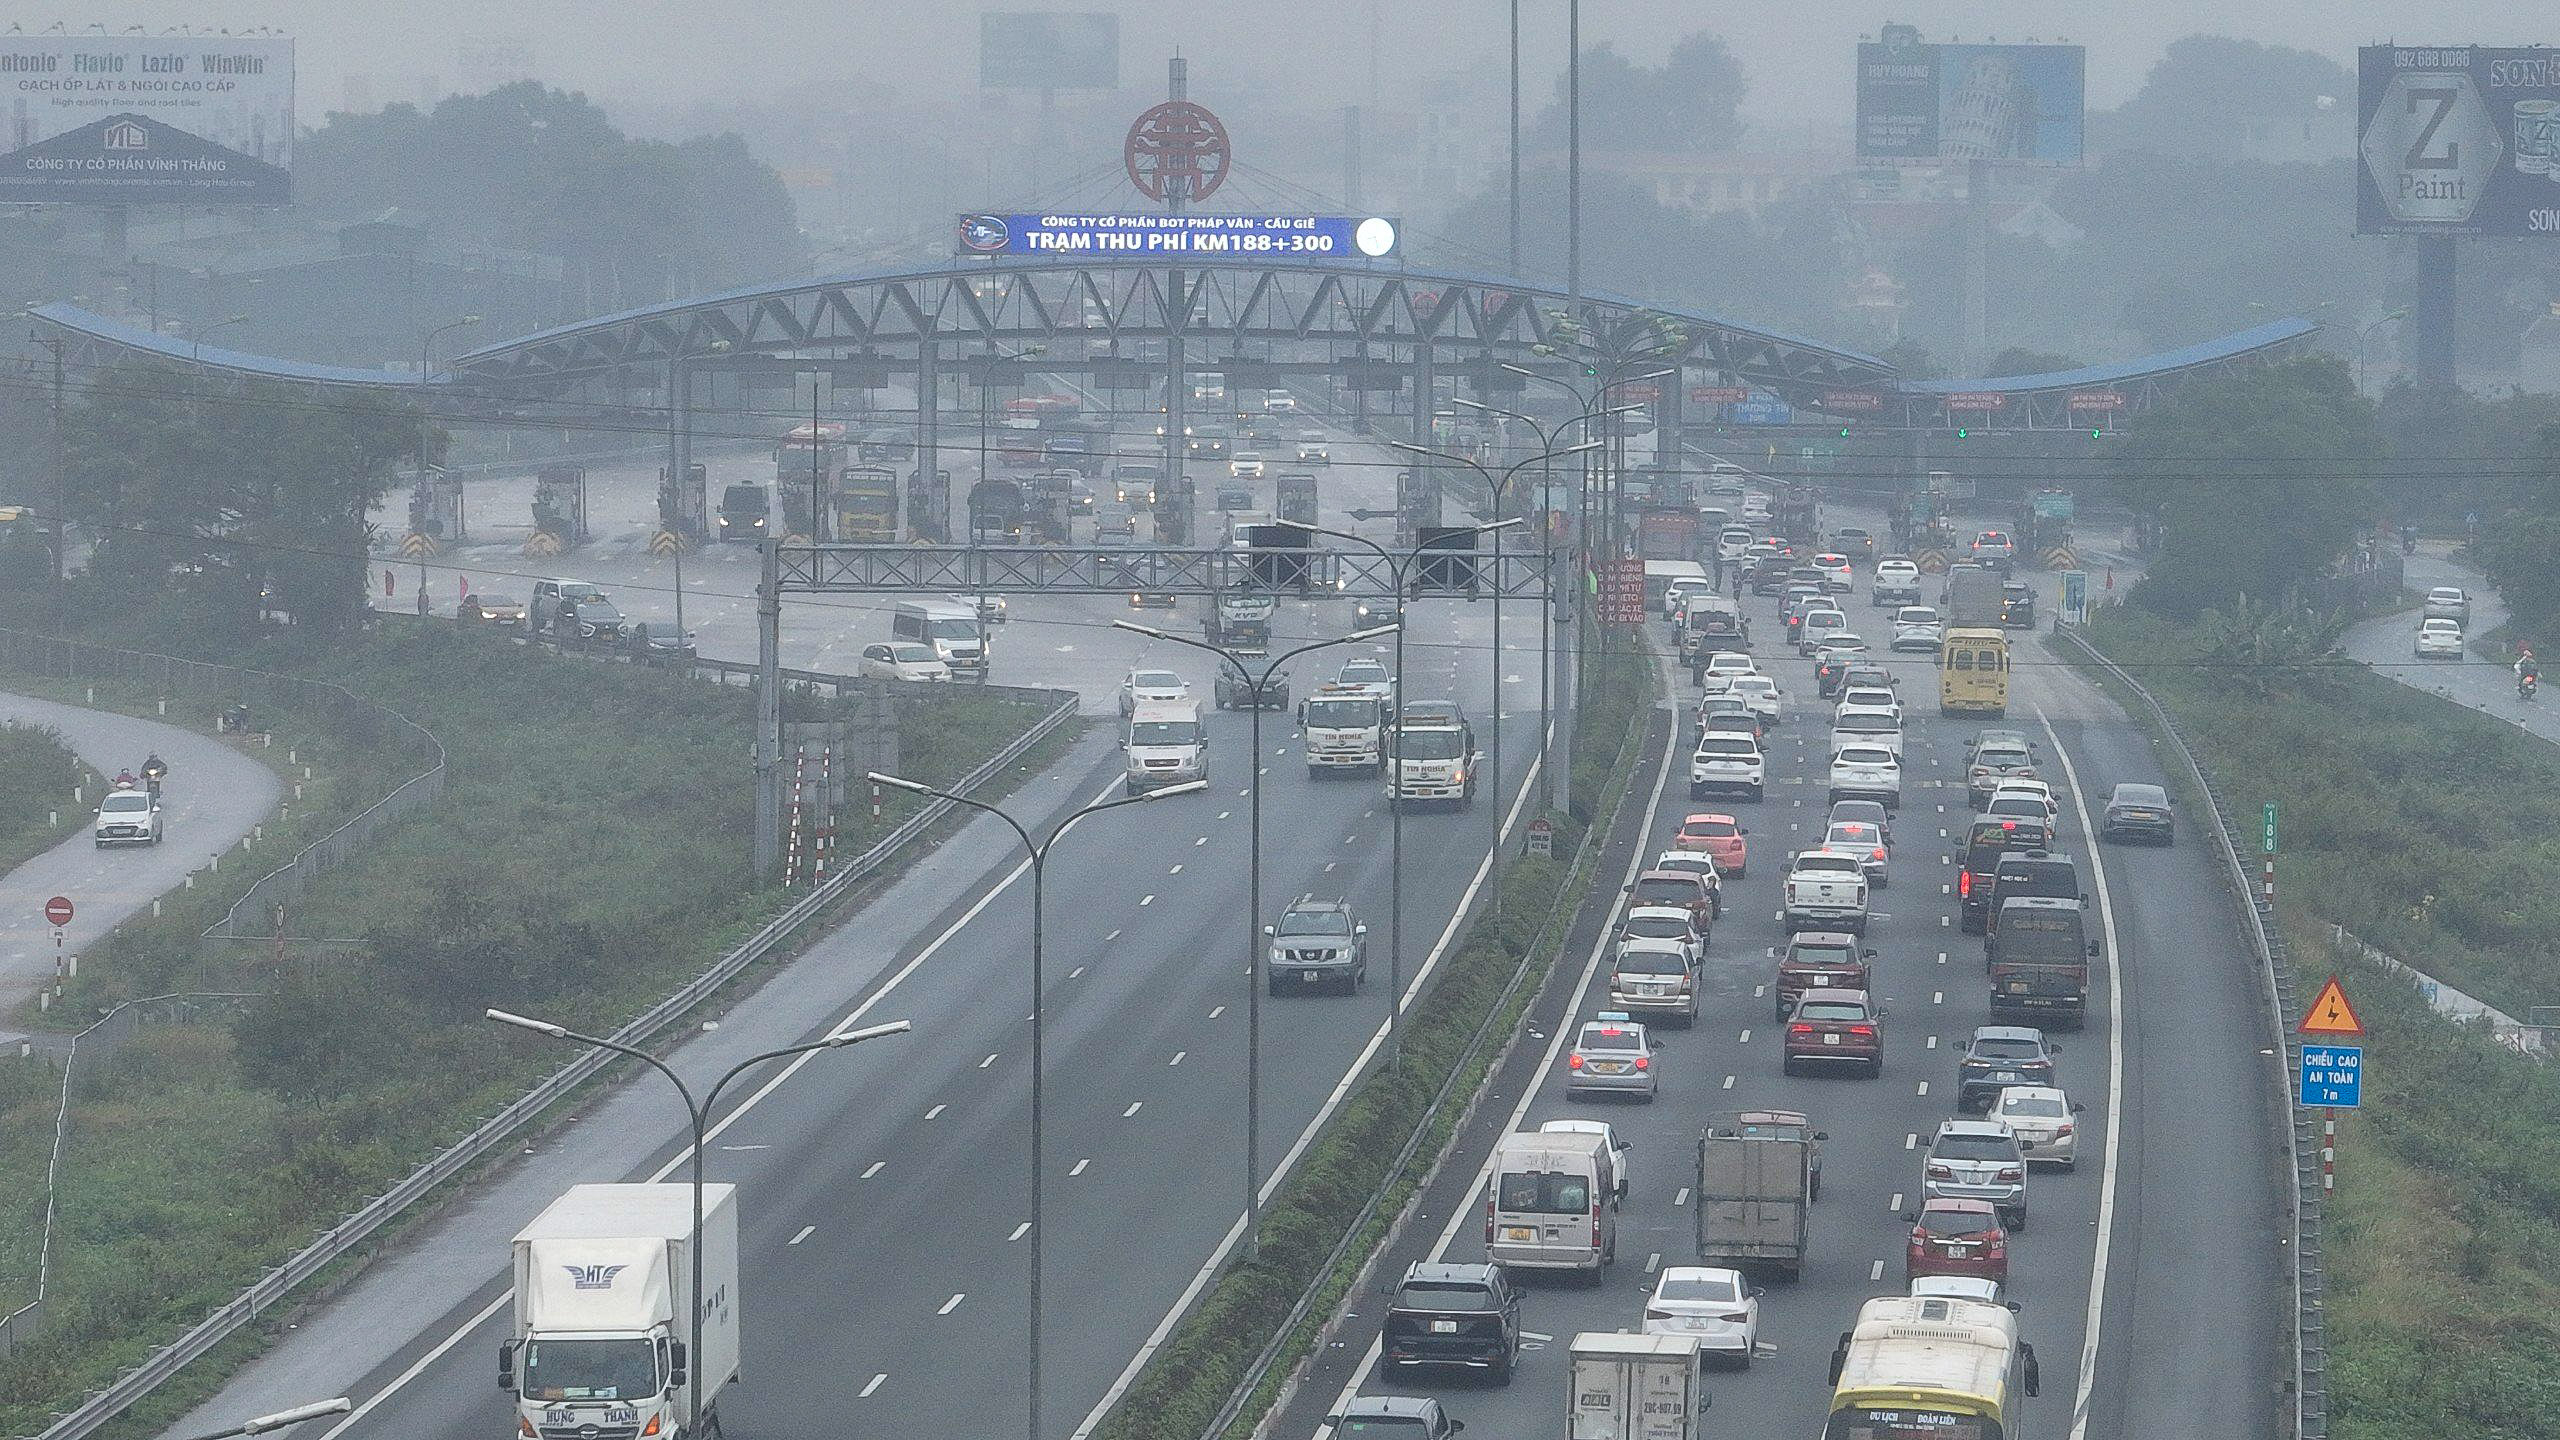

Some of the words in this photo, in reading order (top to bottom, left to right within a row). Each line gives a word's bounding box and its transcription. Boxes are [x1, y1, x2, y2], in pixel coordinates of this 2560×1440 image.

[0, 52, 56, 72] ntonio
[73, 52, 124, 72] Flavio
[141, 53, 184, 73] Lazio
[201, 53, 263, 74] WinWin
[117, 80, 127, 91] &
[171, 80, 202, 92] CAO
[2404, 88, 2459, 170] Z
[26, 156, 64, 170] CÔNG
[66, 158, 83, 170] TY
[2397, 173, 2467, 200] Paint
[1041, 215, 1078, 227] CÔNG
[1080, 217, 1097, 227] TY
[1159, 218, 1185, 228] BOT
[1187, 217, 1225, 229] PHÁP
[1226, 217, 1254, 229] VÂN
[1026, 232, 1091, 253] TRẠM
[1095, 232, 1142, 250] THU
[1148, 230, 1189, 250] PHÍ
[1193, 233, 1334, 251] KM188+300
[2265, 810, 2274, 851] 188
[2337, 1055, 2358, 1068] CAO
[2309, 1071, 2323, 1083] AN
[2327, 1068, 2354, 1084] TOÀN
[2322, 1088, 2329, 1100] 7
[2329, 1091, 2338, 1100] m
[586, 1265, 605, 1282] HT
